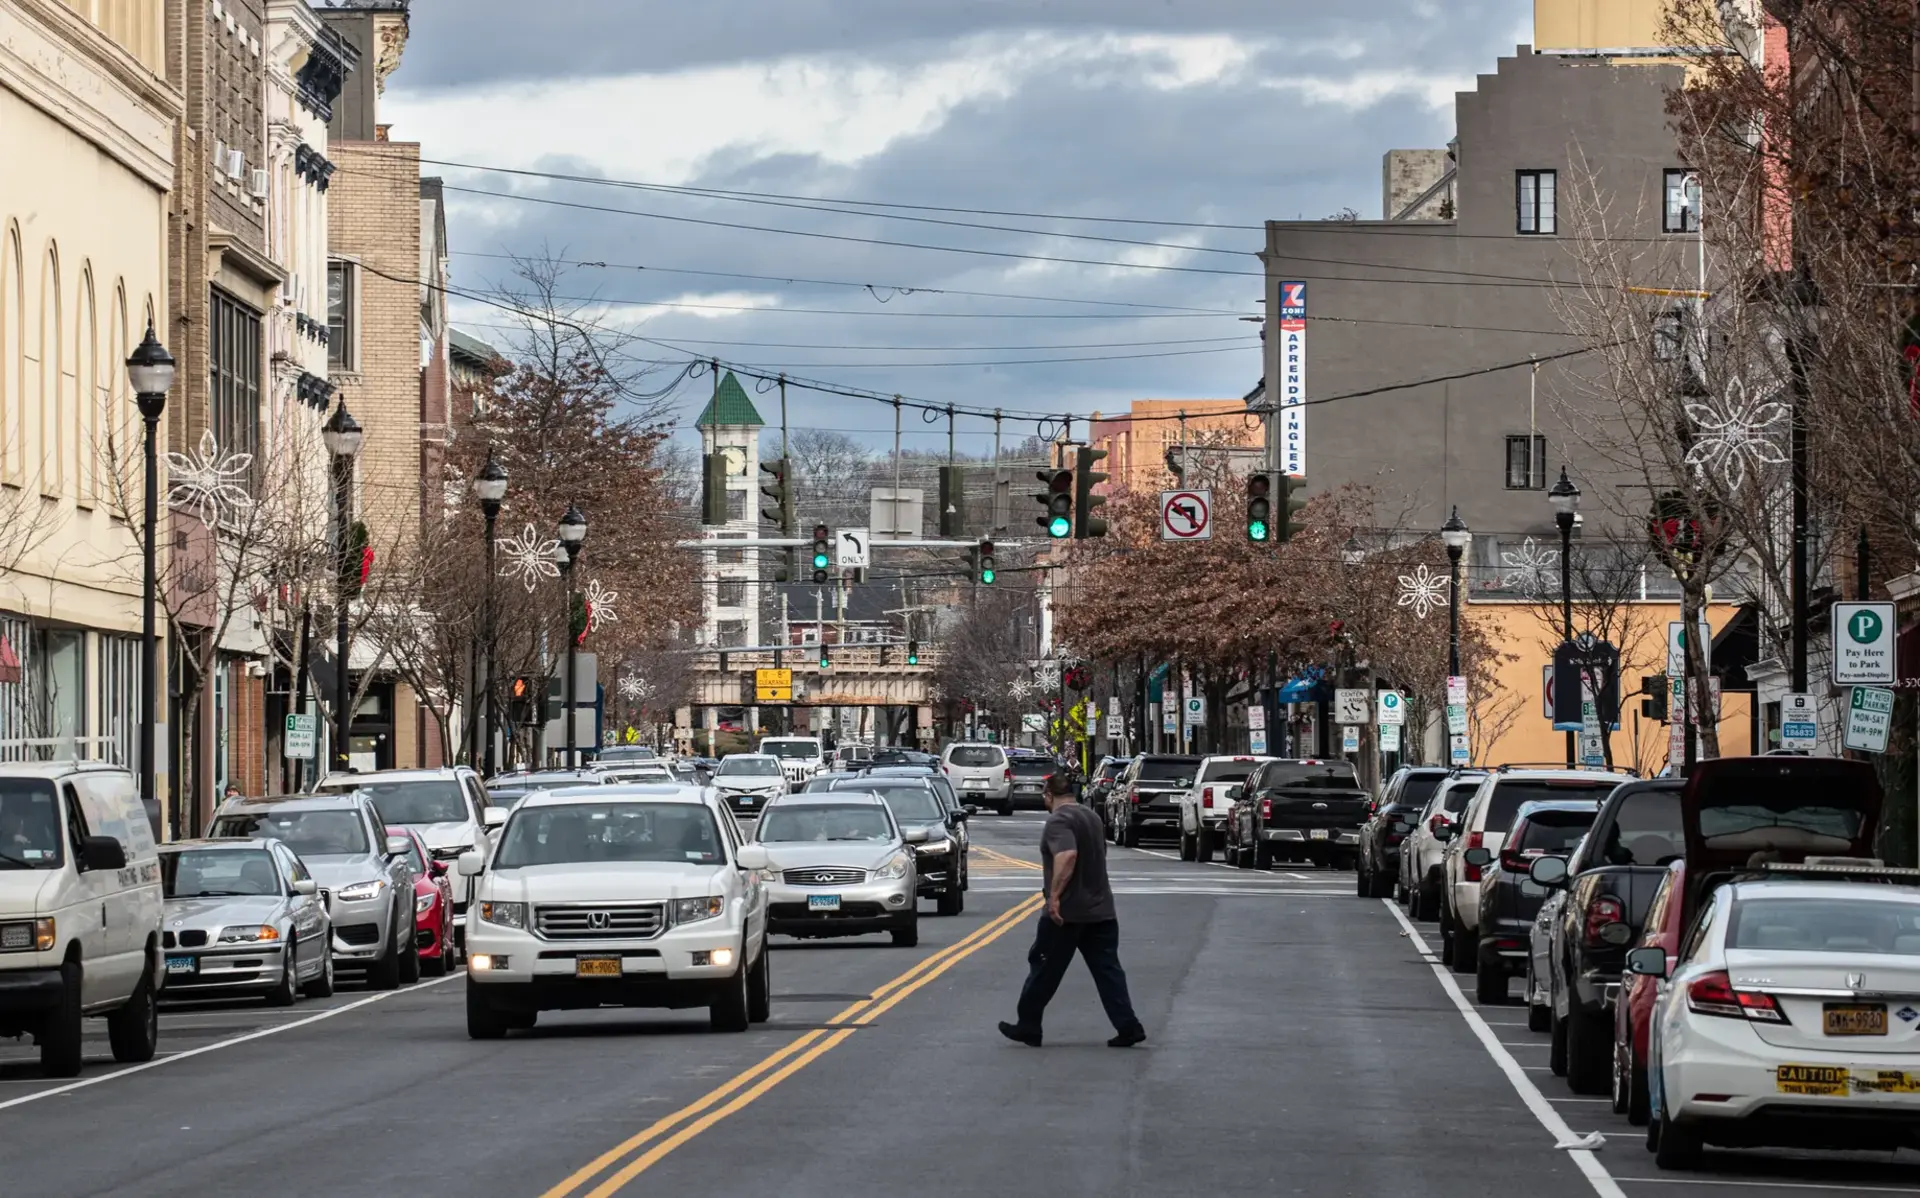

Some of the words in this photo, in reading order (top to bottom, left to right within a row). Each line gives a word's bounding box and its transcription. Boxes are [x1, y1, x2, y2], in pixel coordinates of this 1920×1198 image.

[1288, 411, 1299, 472] INGLES
[841, 556, 864, 564] ONLY
[1856, 615, 1875, 638] P
[1845, 649, 1860, 658] Pay
[1864, 649, 1885, 657] Here
[1860, 660, 1881, 668] Park
[1341, 690, 1364, 698] CENTER
[1854, 690, 1863, 706] 3
[1387, 696, 1396, 706] P
[1864, 700, 1889, 711] PARKING
[1192, 702, 1198, 711] P
[288, 717, 295, 729] 3
[1854, 712, 1885, 725] MON-SAT
[1785, 729, 1815, 737] 186833
[1851, 724, 1884, 736] 9AM-9PM
[1783, 1084, 1802, 1093] THIS
